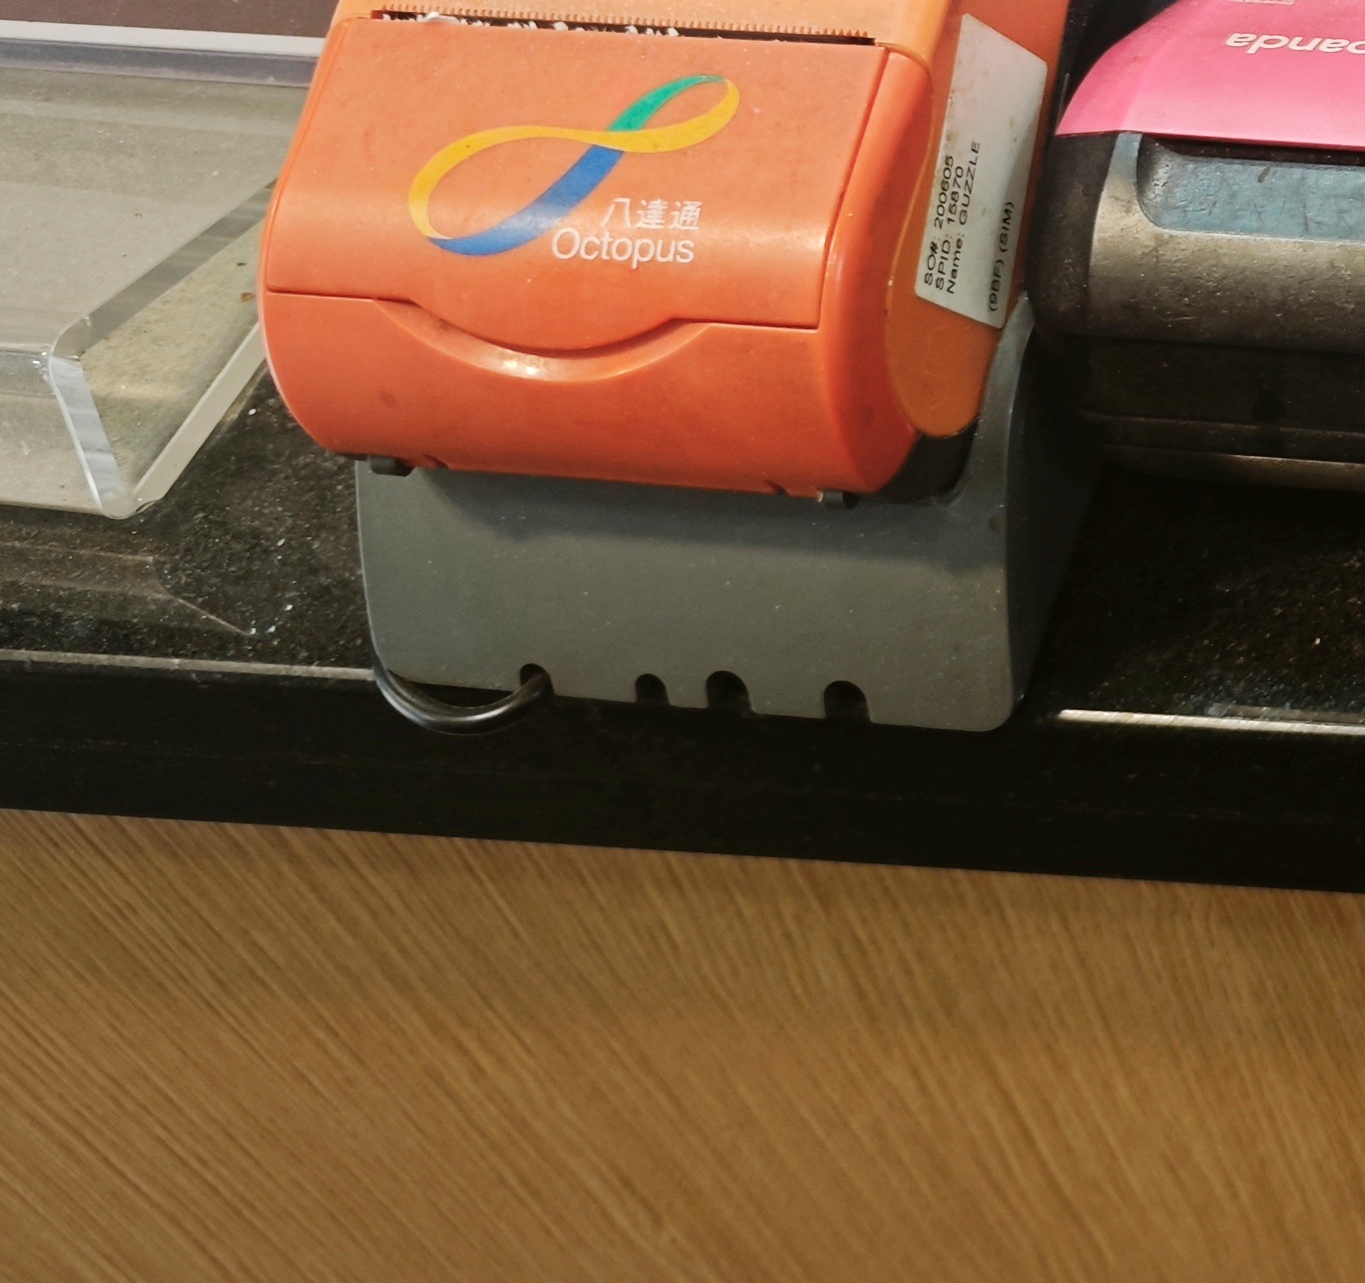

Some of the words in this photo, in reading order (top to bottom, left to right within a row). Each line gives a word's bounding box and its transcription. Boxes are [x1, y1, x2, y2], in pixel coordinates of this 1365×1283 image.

[600, 197, 701, 231] 八達通
[946, 234, 965, 294] Name:
[960, 141, 981, 225] GUZZLE
[551, 226, 696, 270] Octopus
[935, 234, 953, 290] SPID:
